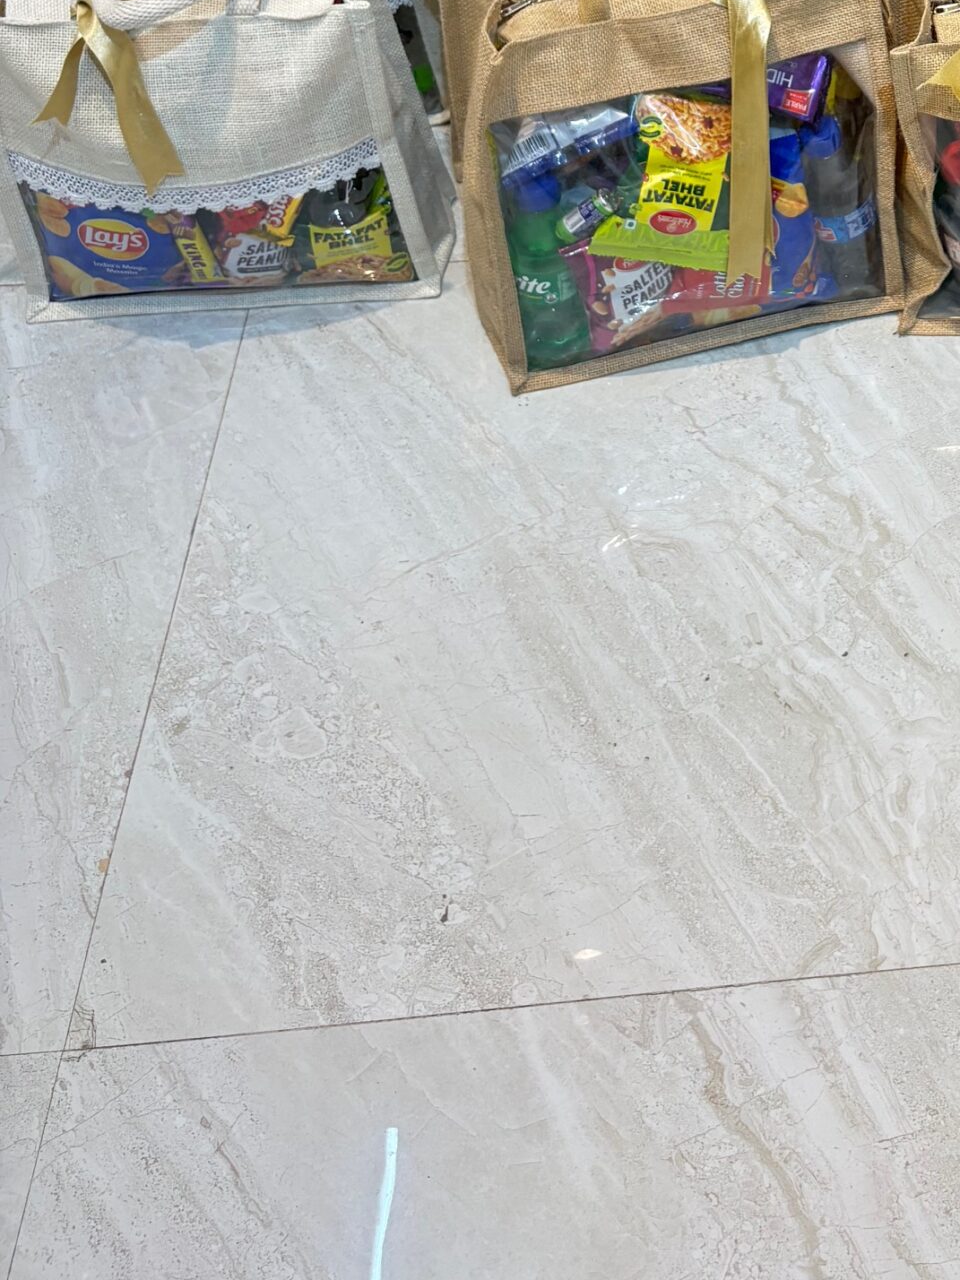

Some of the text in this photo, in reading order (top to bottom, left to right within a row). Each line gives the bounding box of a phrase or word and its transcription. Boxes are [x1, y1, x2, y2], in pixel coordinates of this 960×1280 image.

[767, 68, 793, 88] HID
[661, 178, 707, 196] BHEL
[642, 190, 715, 212] FATAFAT
[85, 226, 143, 252] Lay's
[518, 275, 550, 294] rite
